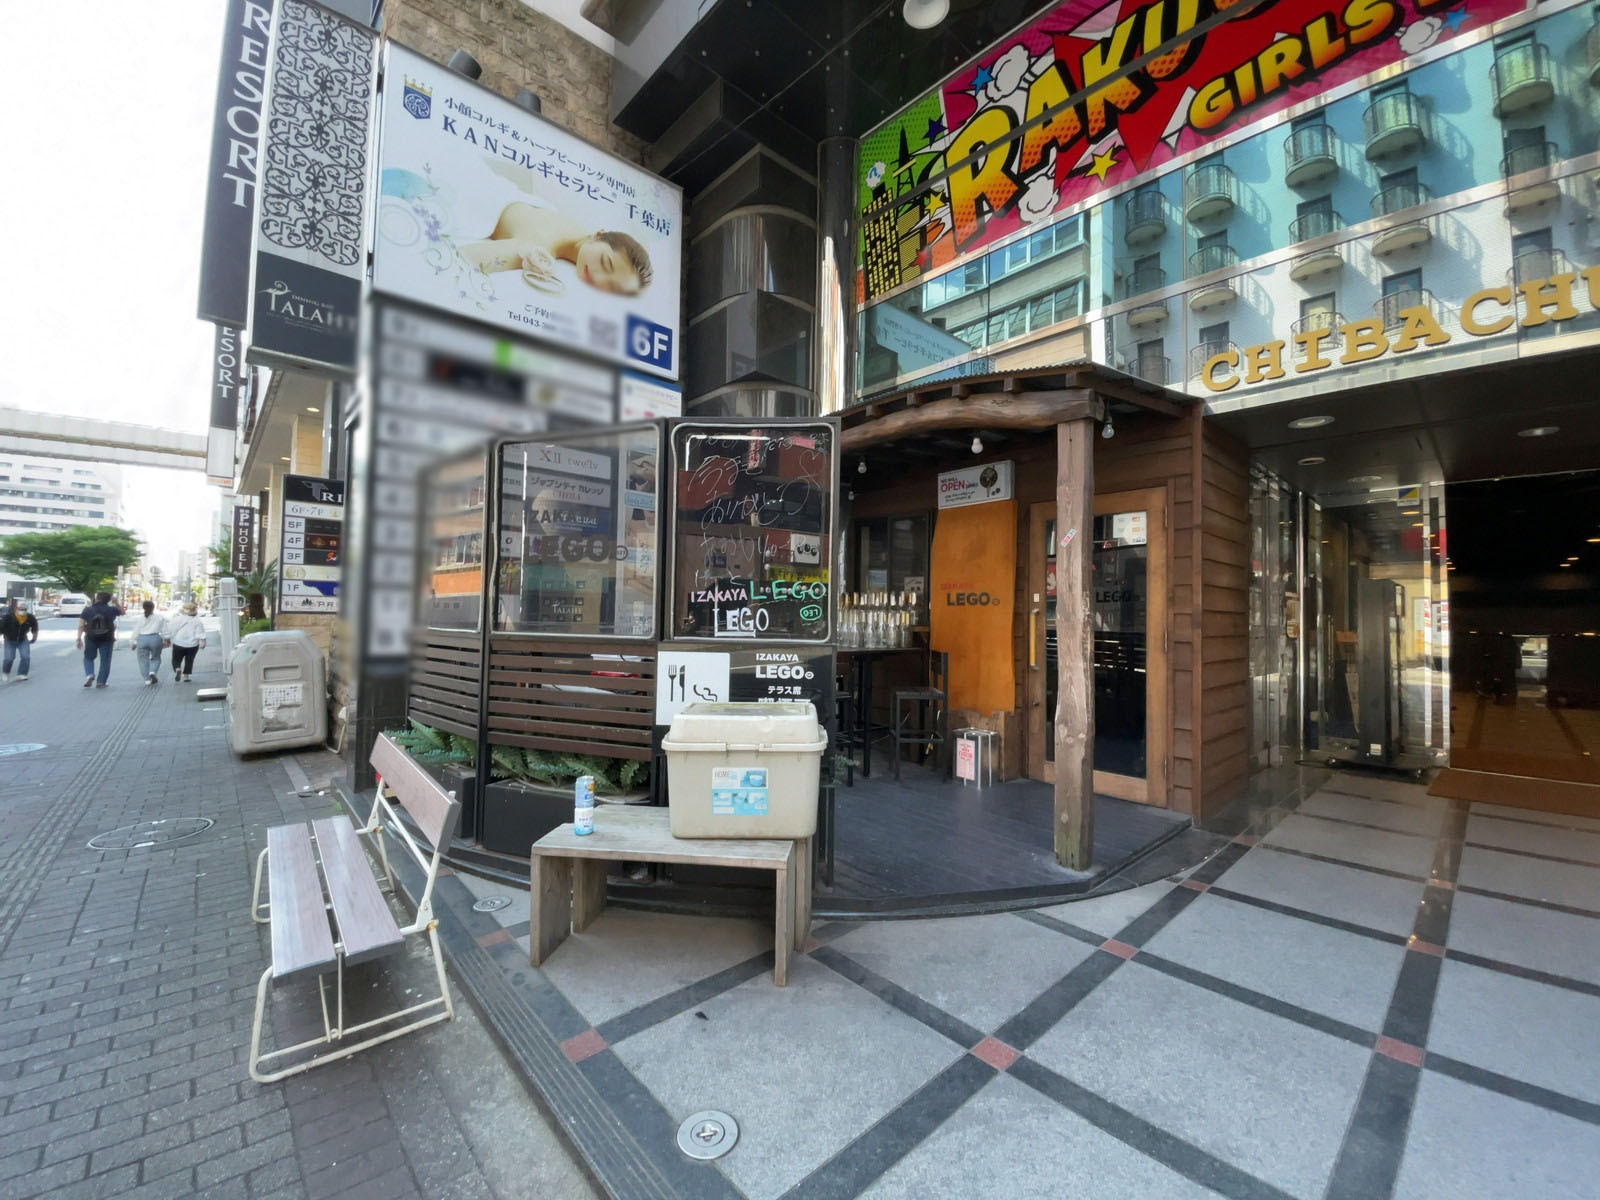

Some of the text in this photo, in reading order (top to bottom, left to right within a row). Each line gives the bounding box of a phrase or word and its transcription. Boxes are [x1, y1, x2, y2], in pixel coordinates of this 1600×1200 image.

[1187, 0, 1397, 130] GIRLS
[223, 0, 270, 208] RESORT
[625, 203, 672, 236] 千葉店
[632, 325, 669, 360] 6F
[941, 480, 965, 492] OPEN
[288, 521, 302, 529] 5F
[238, 528, 249, 569] HOTEL
[287, 537, 302, 545] 4F
[287, 552, 301, 560] 3F
[691, 580, 827, 603] IZAKAYA LEGO
[946, 592, 991, 607] LEGO
[713, 607, 769, 638] LEGO
[756, 653, 799, 662] IZAKAYA
[755, 664, 804, 680] LEGO
